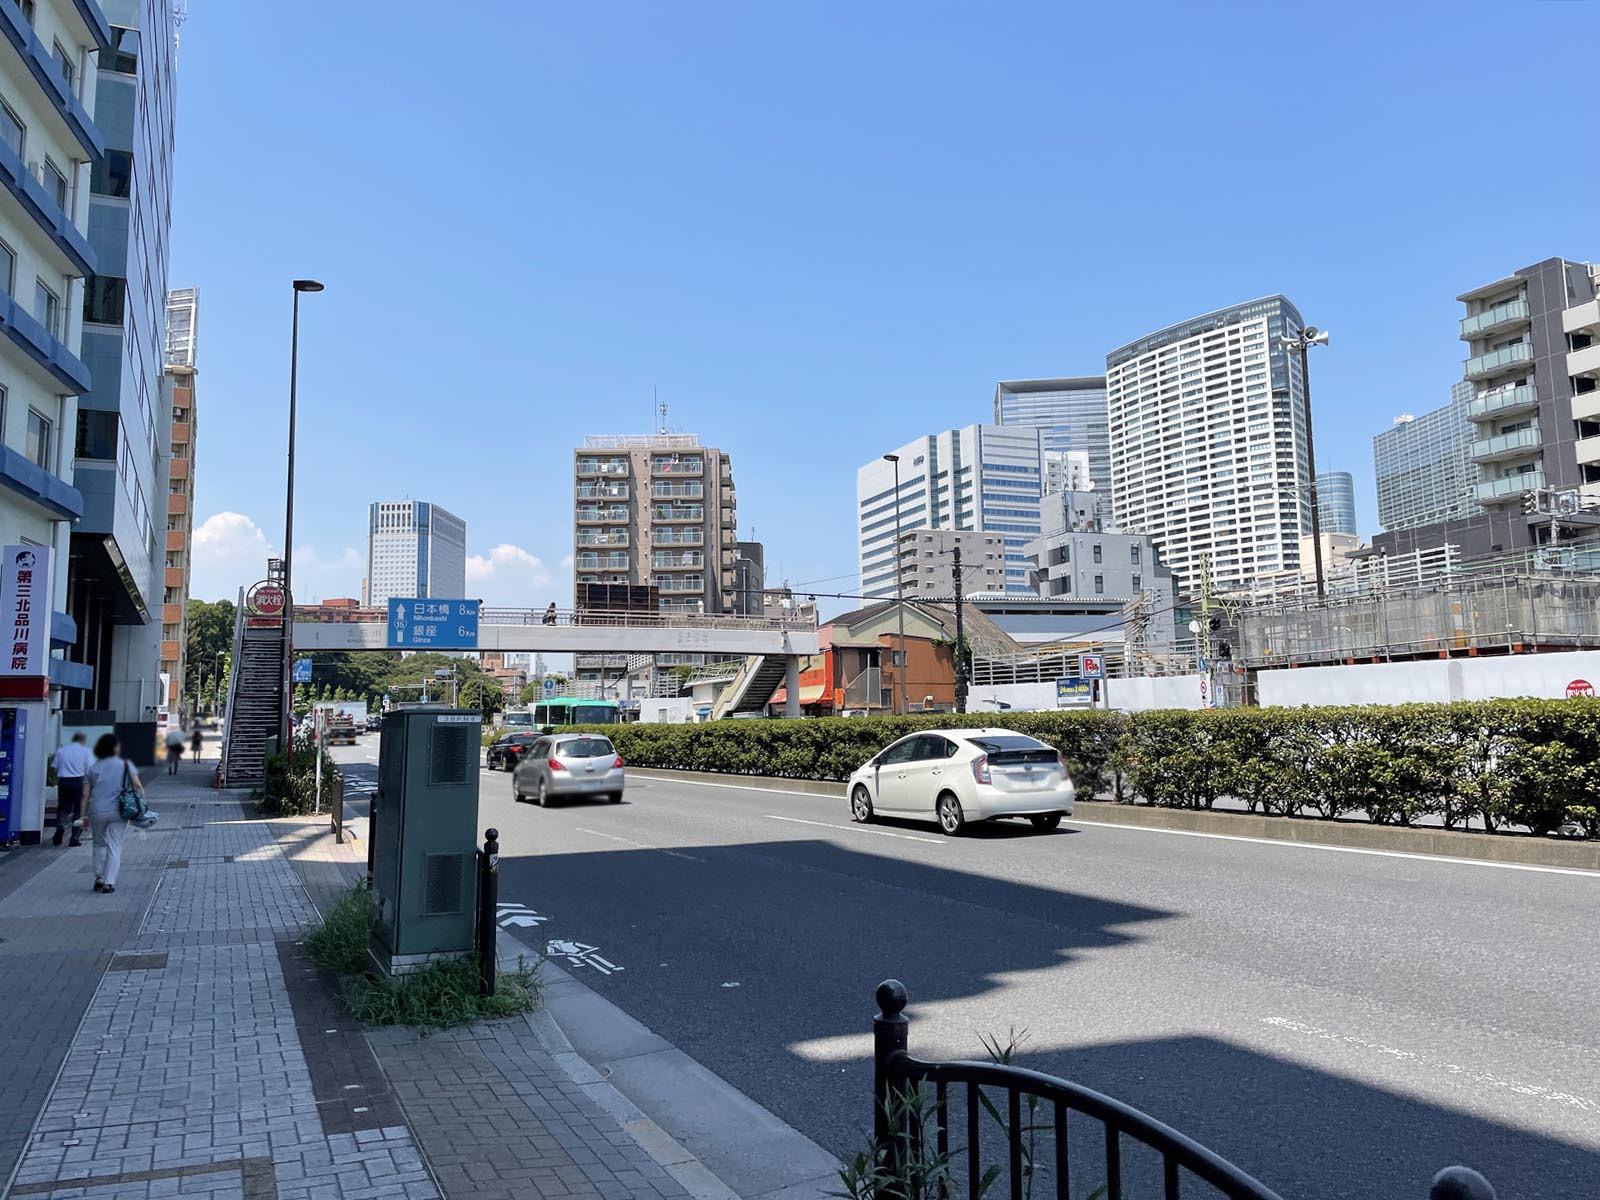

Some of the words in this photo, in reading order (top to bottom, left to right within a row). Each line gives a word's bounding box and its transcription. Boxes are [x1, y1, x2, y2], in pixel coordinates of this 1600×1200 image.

[256, 594, 282, 606] 消火栓
[414, 603, 449, 615] 日本橋
[11, 570, 32, 670] 第三北品川病院
[396, 621, 404, 629] 15
[413, 624, 438, 637] 銀座
